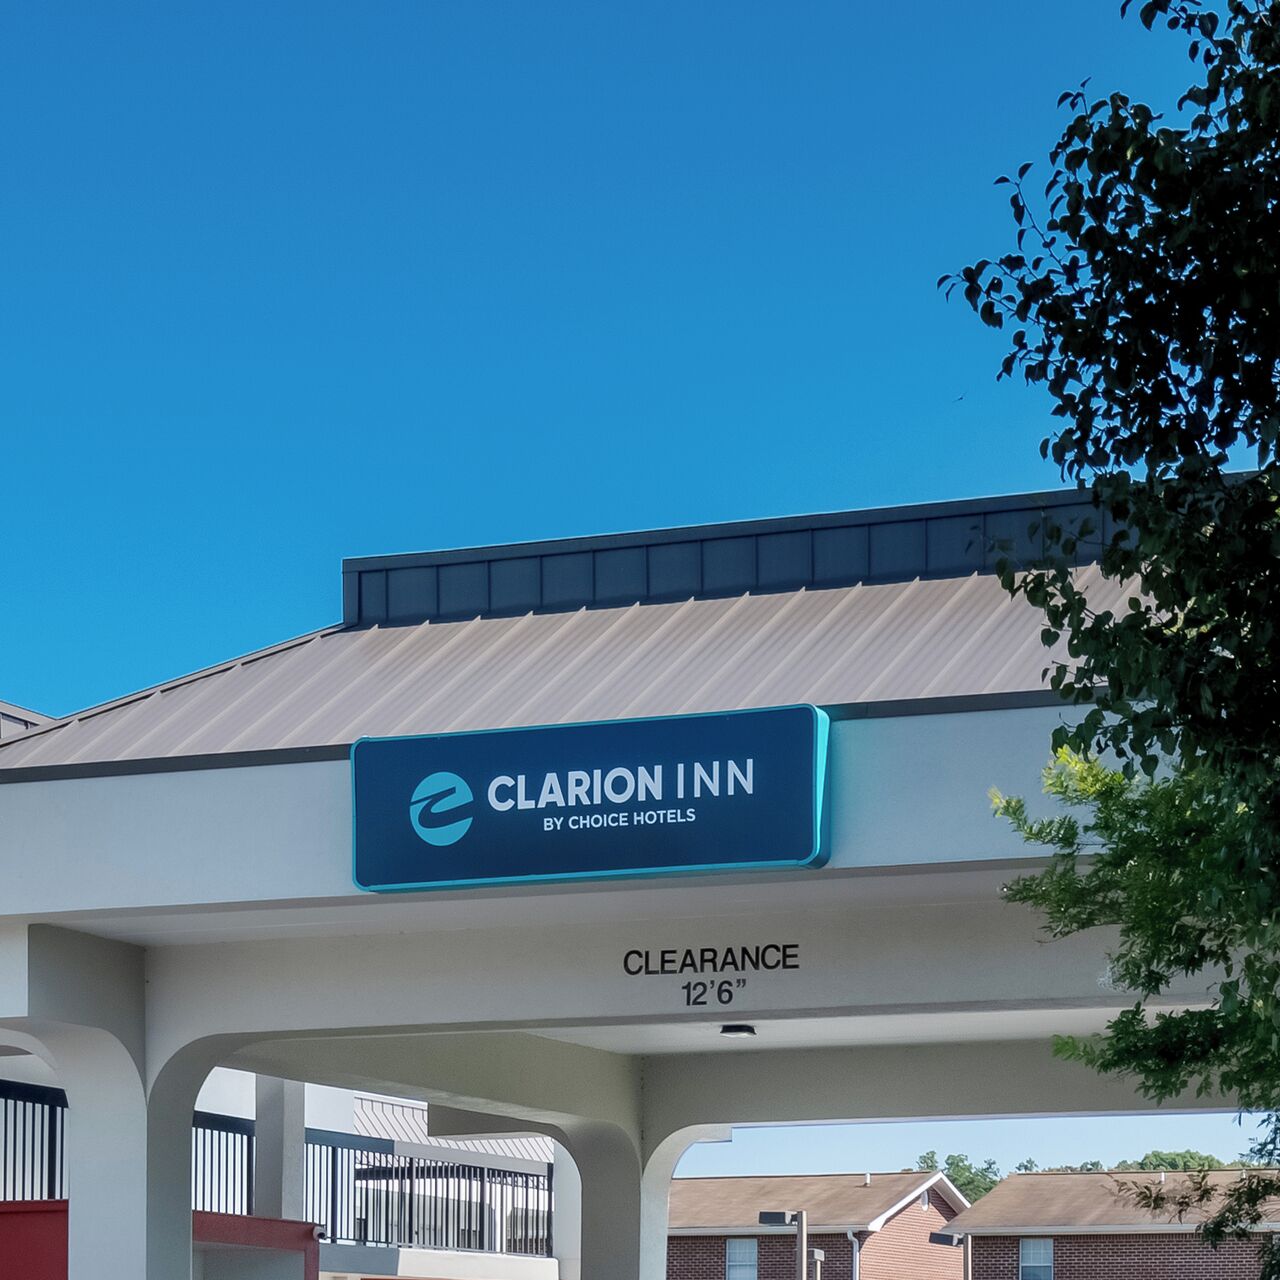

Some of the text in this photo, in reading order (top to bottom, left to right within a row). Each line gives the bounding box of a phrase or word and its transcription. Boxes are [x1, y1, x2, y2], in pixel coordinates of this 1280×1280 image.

[487, 758, 754, 812] CLARION INN
[543, 808, 696, 831] BY CHOICE HOTELS
[623, 943, 800, 976] CLEARANCE
